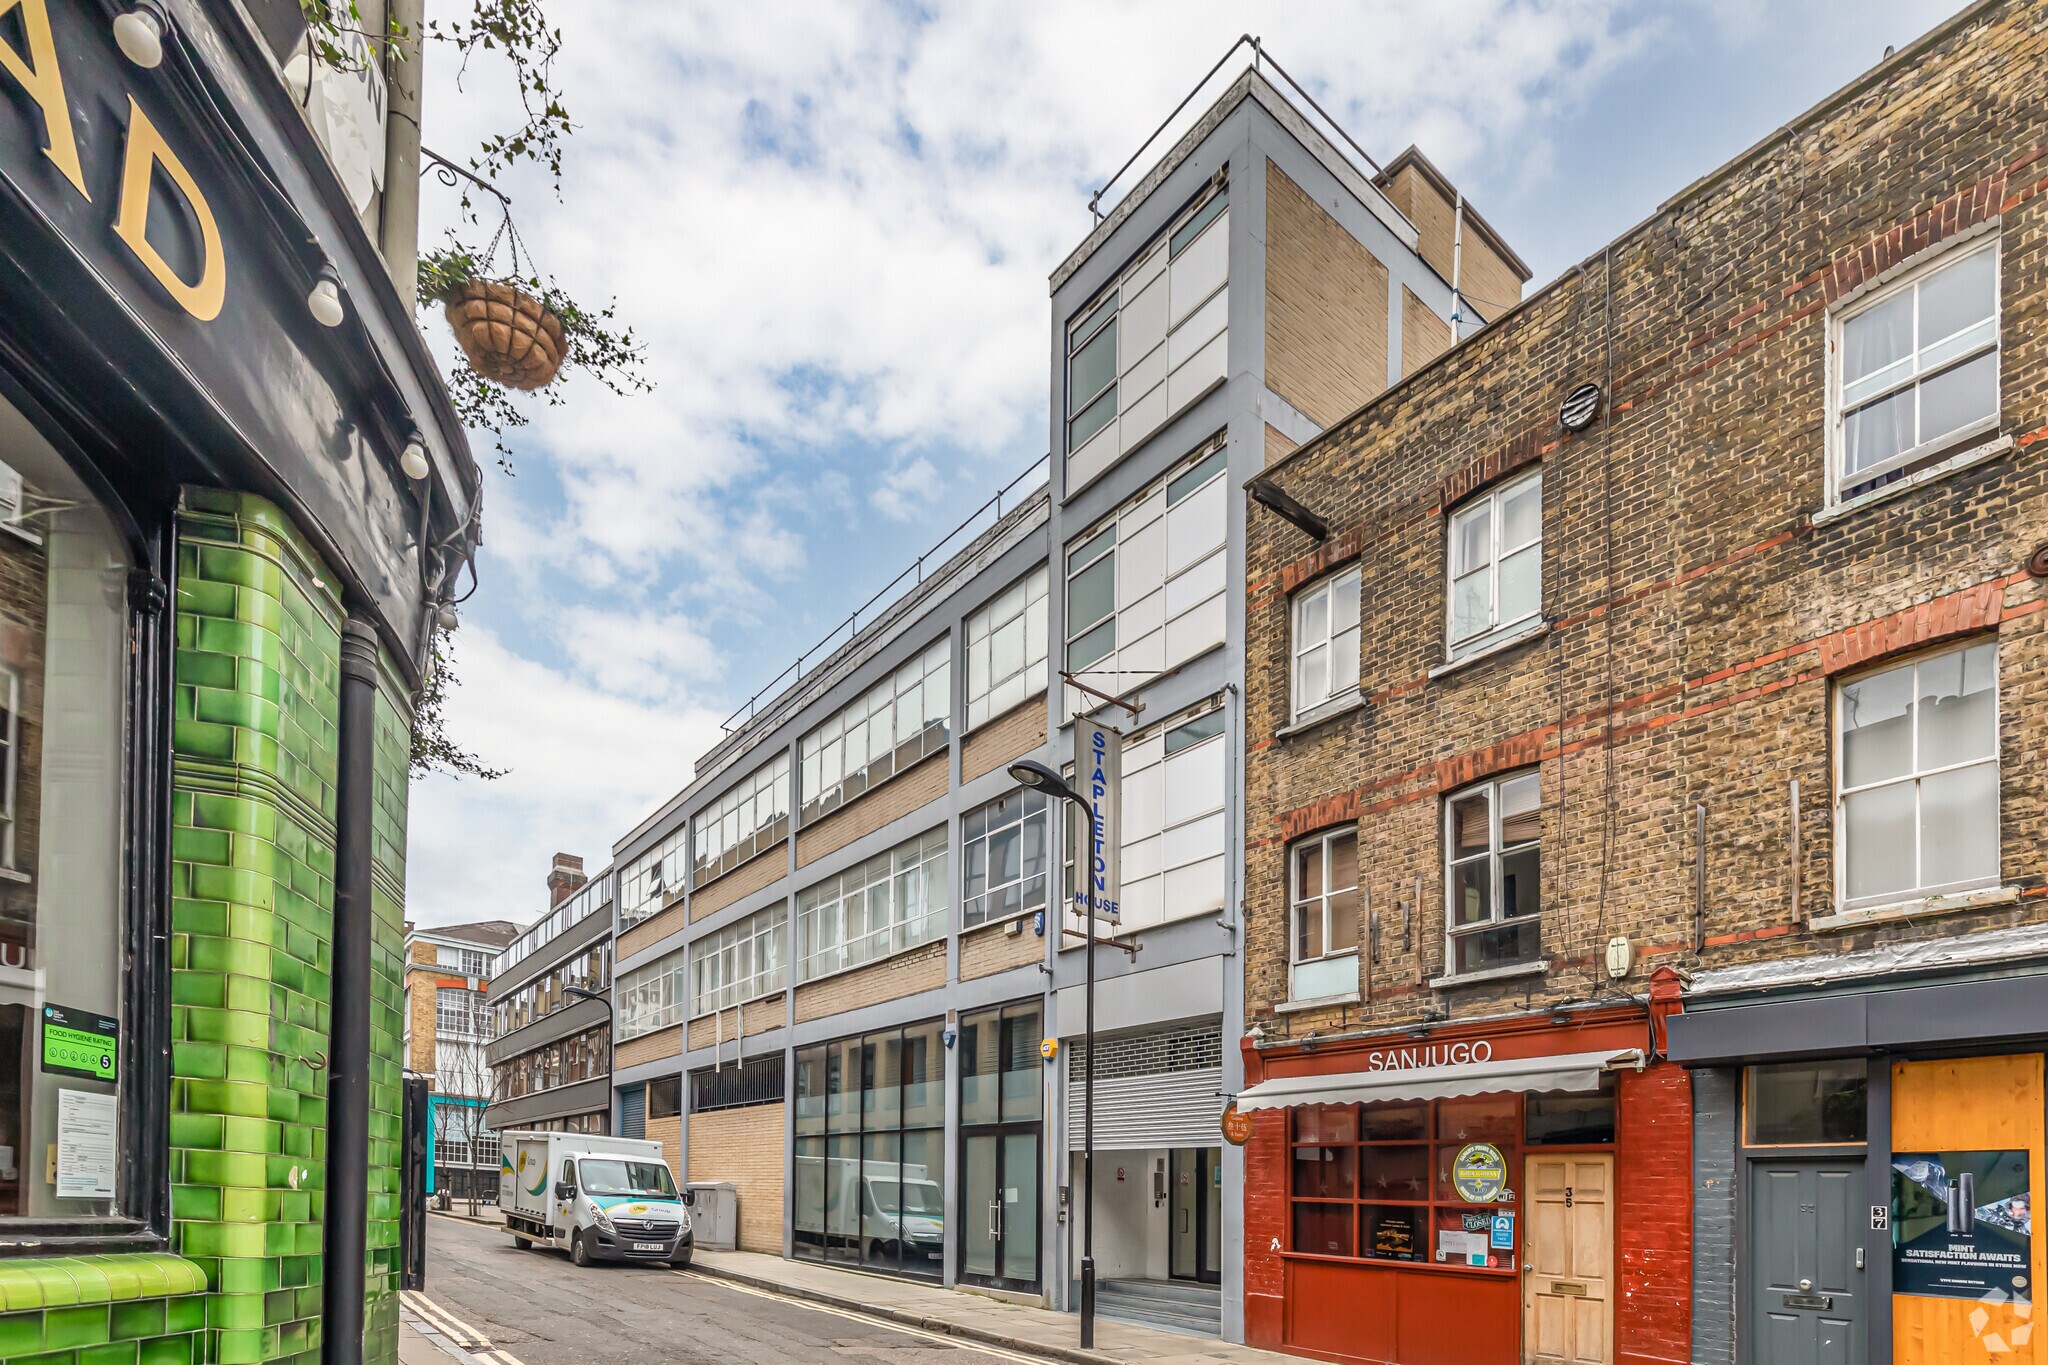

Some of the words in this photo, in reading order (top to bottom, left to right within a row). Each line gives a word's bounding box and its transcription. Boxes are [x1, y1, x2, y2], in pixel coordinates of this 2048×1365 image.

[1091, 731, 1107, 891] STAPLETON
[49, 1028, 67, 1037] FOOD
[68, 1034, 92, 1042] HYGIENE
[93, 1038, 112, 1046] RATING
[102, 1056, 110, 1068] 5
[1368, 1040, 1492, 1072] SANJUGO
[1465, 1217, 1491, 1229] CLOSED
[1948, 1244, 1975, 1253] MINT
[1906, 1249, 1978, 1260] SATISFACTION
[1978, 1252, 2021, 1262] AWAITS
